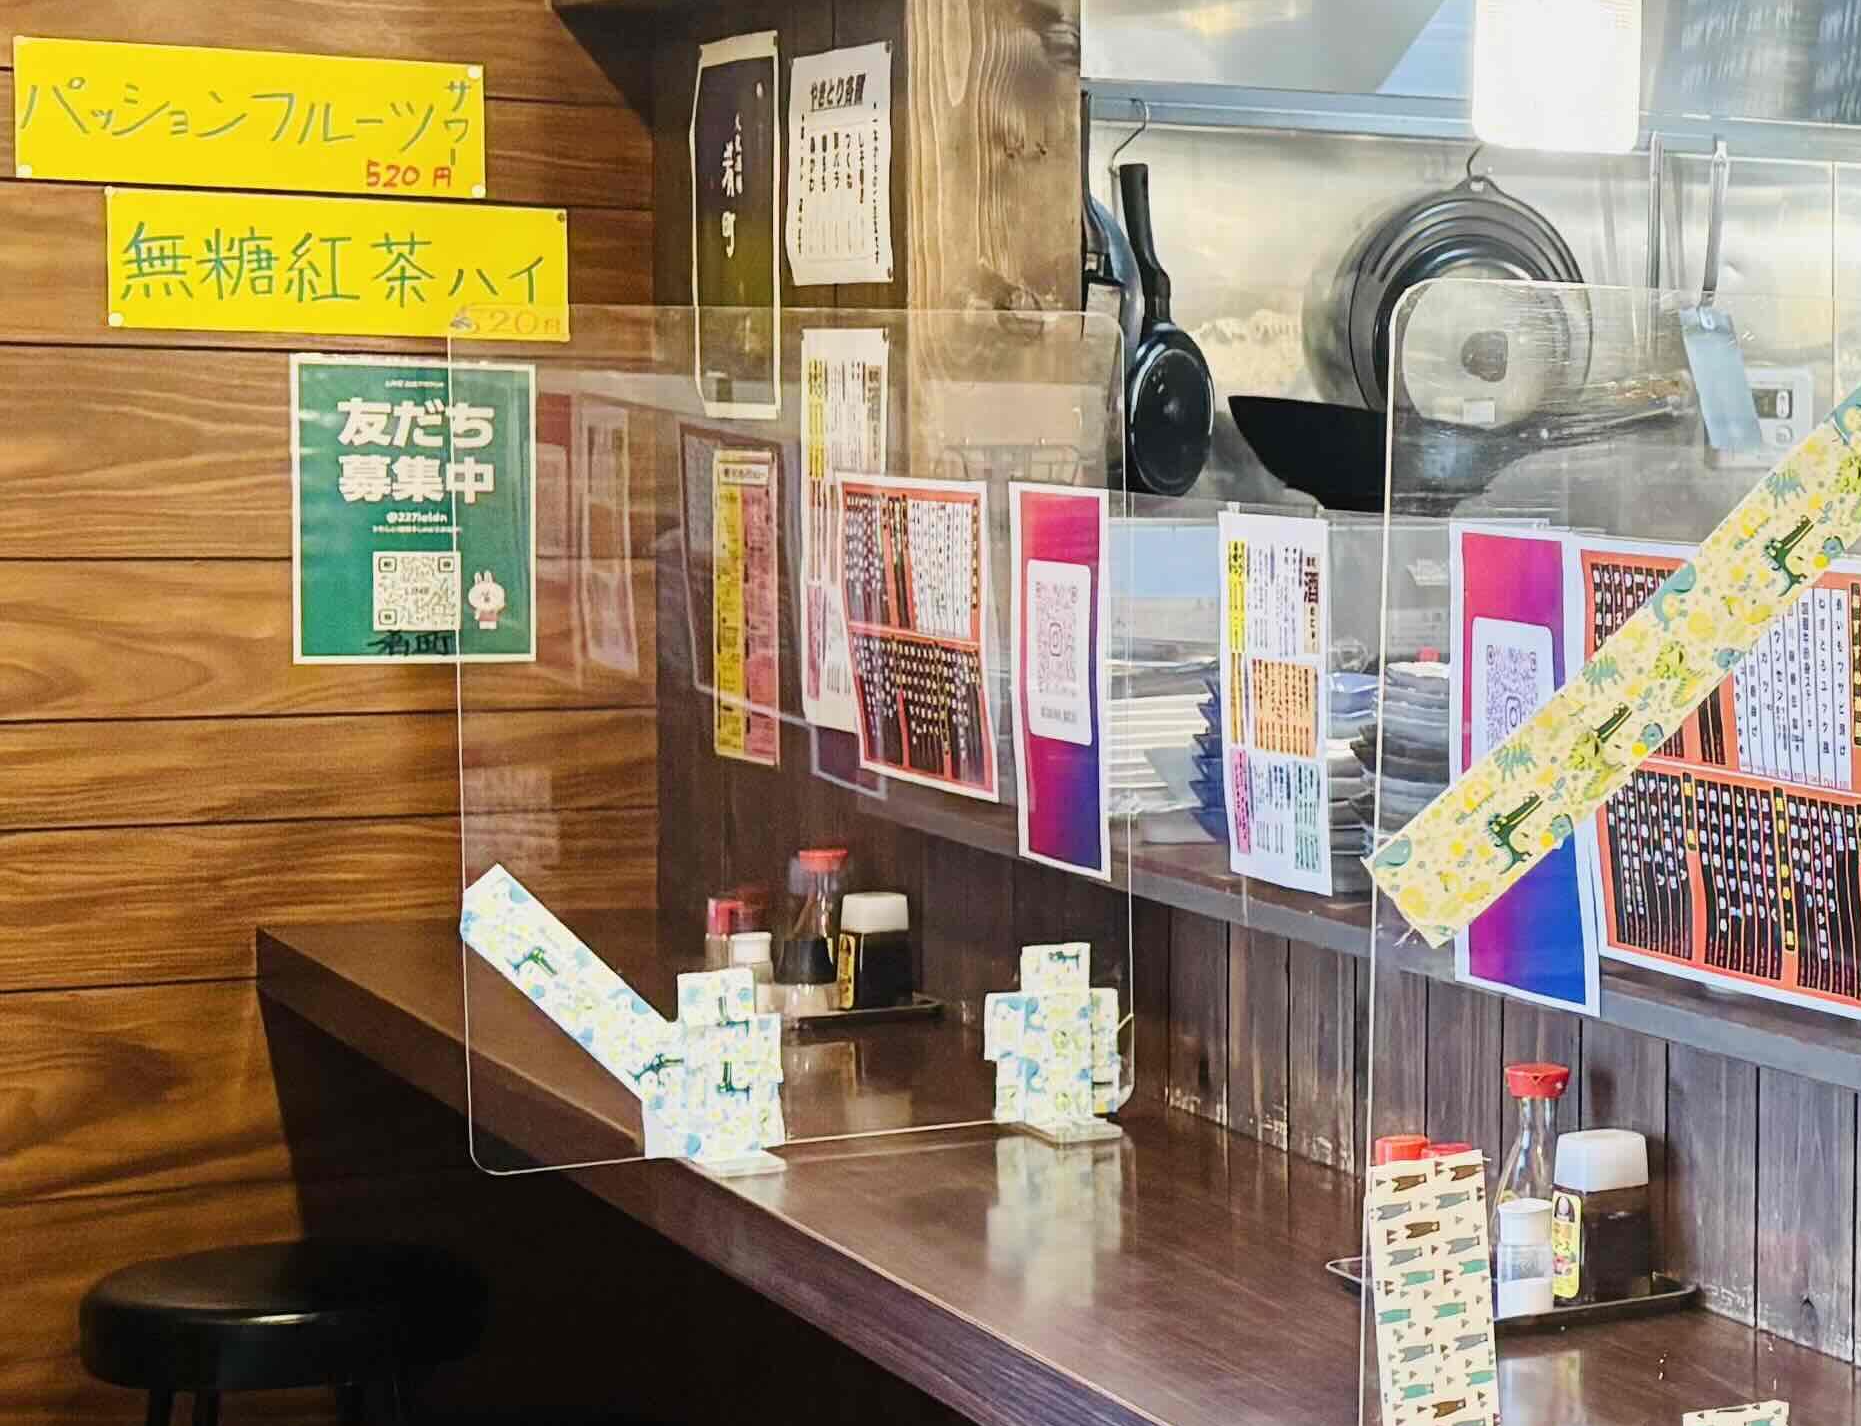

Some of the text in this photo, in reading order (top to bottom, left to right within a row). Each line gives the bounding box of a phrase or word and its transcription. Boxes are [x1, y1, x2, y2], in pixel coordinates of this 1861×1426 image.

[18, 75, 473, 167] パッションフルーツ サワー
[121, 219, 546, 309] 無糖紅茶ハイ
[336, 395, 496, 450] 友だち
[336, 454, 497, 506] 募集中
